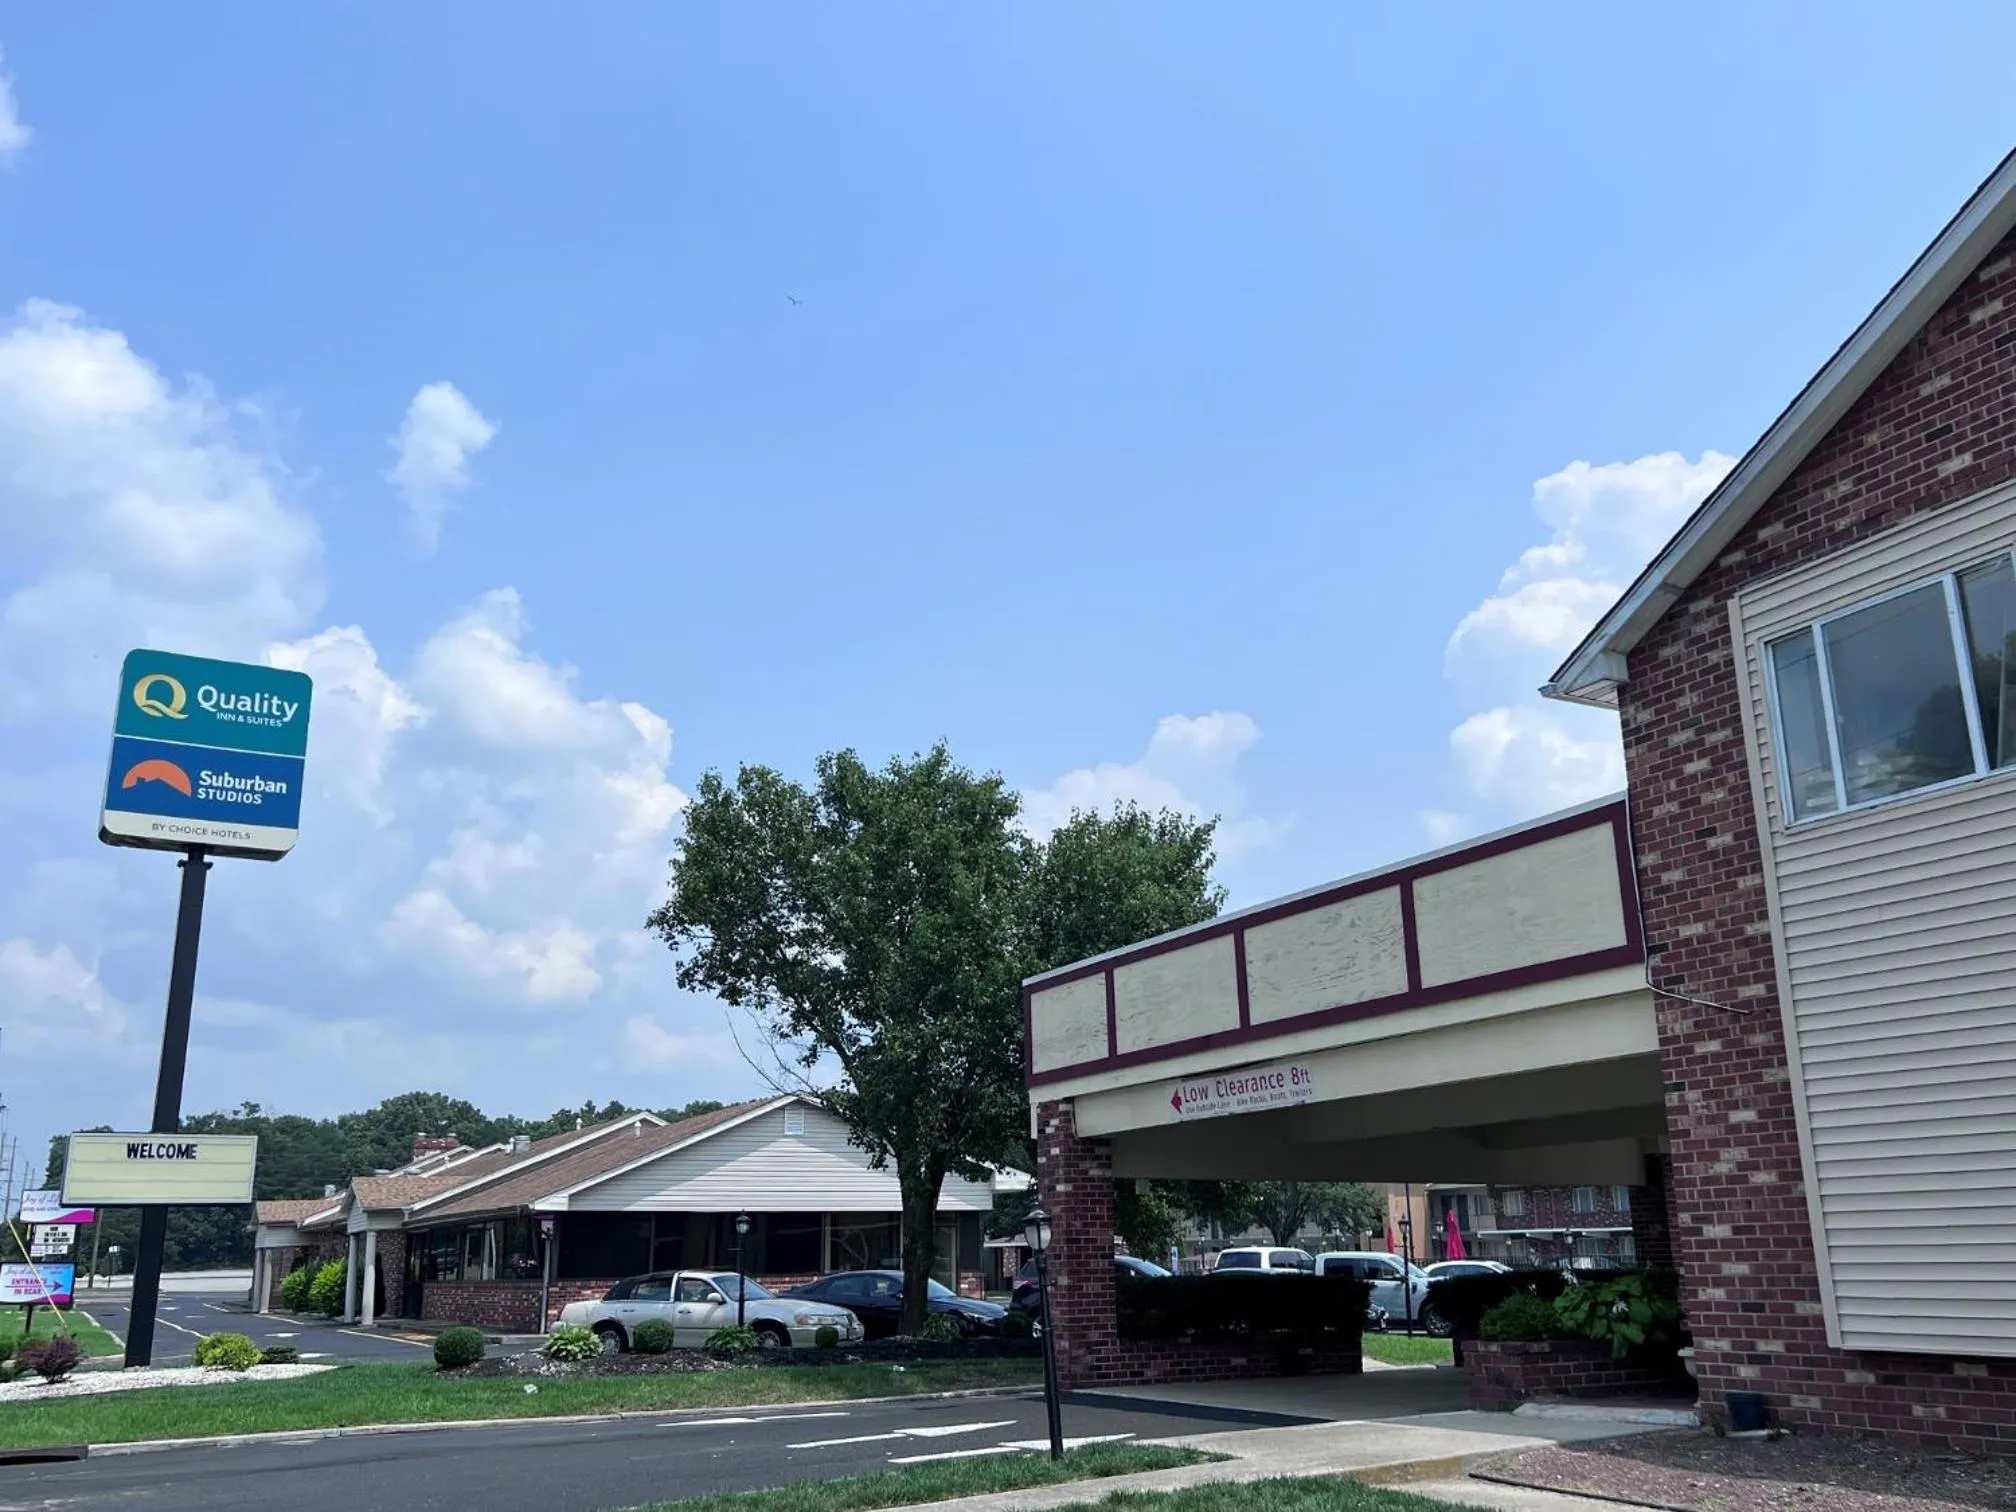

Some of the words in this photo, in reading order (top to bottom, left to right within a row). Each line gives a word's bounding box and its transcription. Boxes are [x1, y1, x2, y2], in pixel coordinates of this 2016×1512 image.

[197, 685, 299, 723] Quality
[216, 712, 236, 722] INN
[237, 714, 244, 723] &
[246, 715, 283, 728] SUITES
[199, 770, 287, 795] Suburban
[197, 787, 263, 805] STUDIOS
[152, 822, 166, 832] BY
[168, 824, 209, 836] CHOICE
[211, 828, 251, 840] HOTELS
[1182, 1084, 1209, 1103] Low
[1215, 1072, 1285, 1098] Clearance
[1290, 1066, 1311, 1086] 8ft
[126, 1142, 198, 1160] WELCOME
